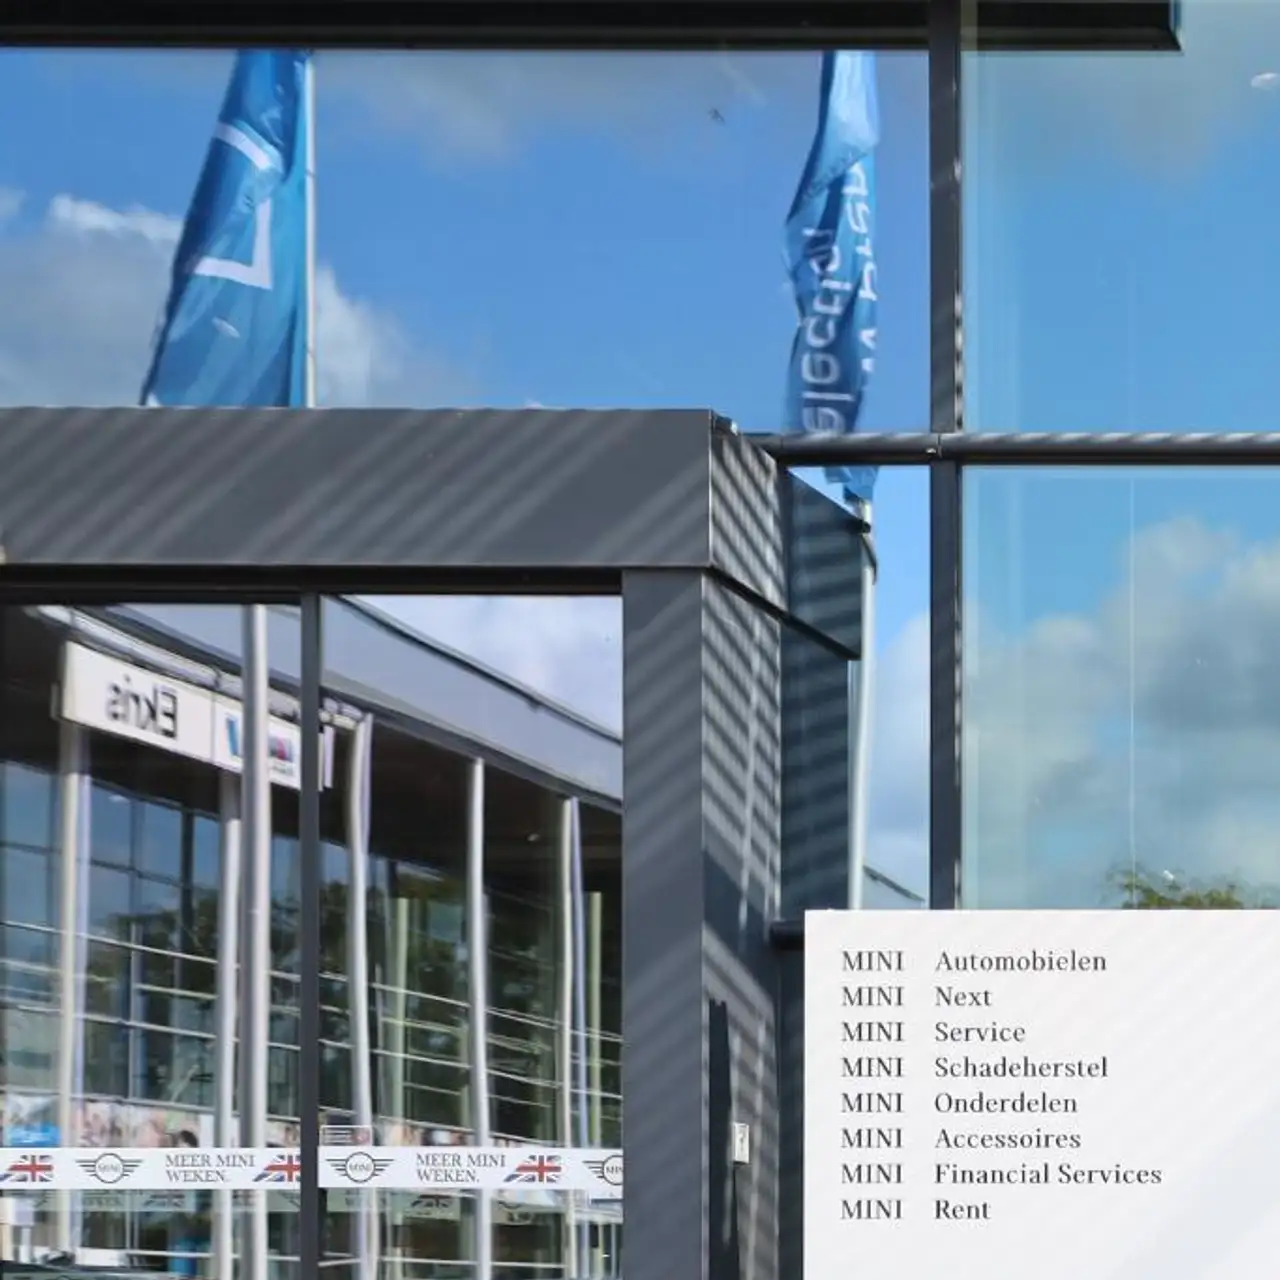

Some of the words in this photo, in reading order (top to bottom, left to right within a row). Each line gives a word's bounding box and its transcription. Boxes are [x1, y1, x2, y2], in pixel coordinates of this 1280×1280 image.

[843, 950, 903, 971] MINI
[936, 949, 1107, 971] Automobielen
[842, 986, 903, 1007] MINI
[935, 986, 991, 1007] Next
[842, 1021, 903, 1042] MINI
[935, 1021, 1026, 1042] Service
[842, 1056, 903, 1078] MINI
[935, 1055, 1108, 1078] Schadeherstel
[842, 1092, 903, 1113] MINI
[934, 1091, 1077, 1113] Onderdelen
[842, 1127, 902, 1149] MINI
[935, 1127, 1081, 1149] Accessoires
[166, 1154, 212, 1168] MEER
[215, 1154, 256, 1168] MINI
[416, 1153, 462, 1168] MEER
[466, 1153, 506, 1168] MINI
[416, 1168, 480, 1183] WEKEN.
[842, 1163, 902, 1184] MINI
[934, 1162, 1049, 1184] Financial
[1057, 1163, 1162, 1184] Services
[842, 1199, 902, 1220] MINI
[935, 1199, 990, 1220] Rent
